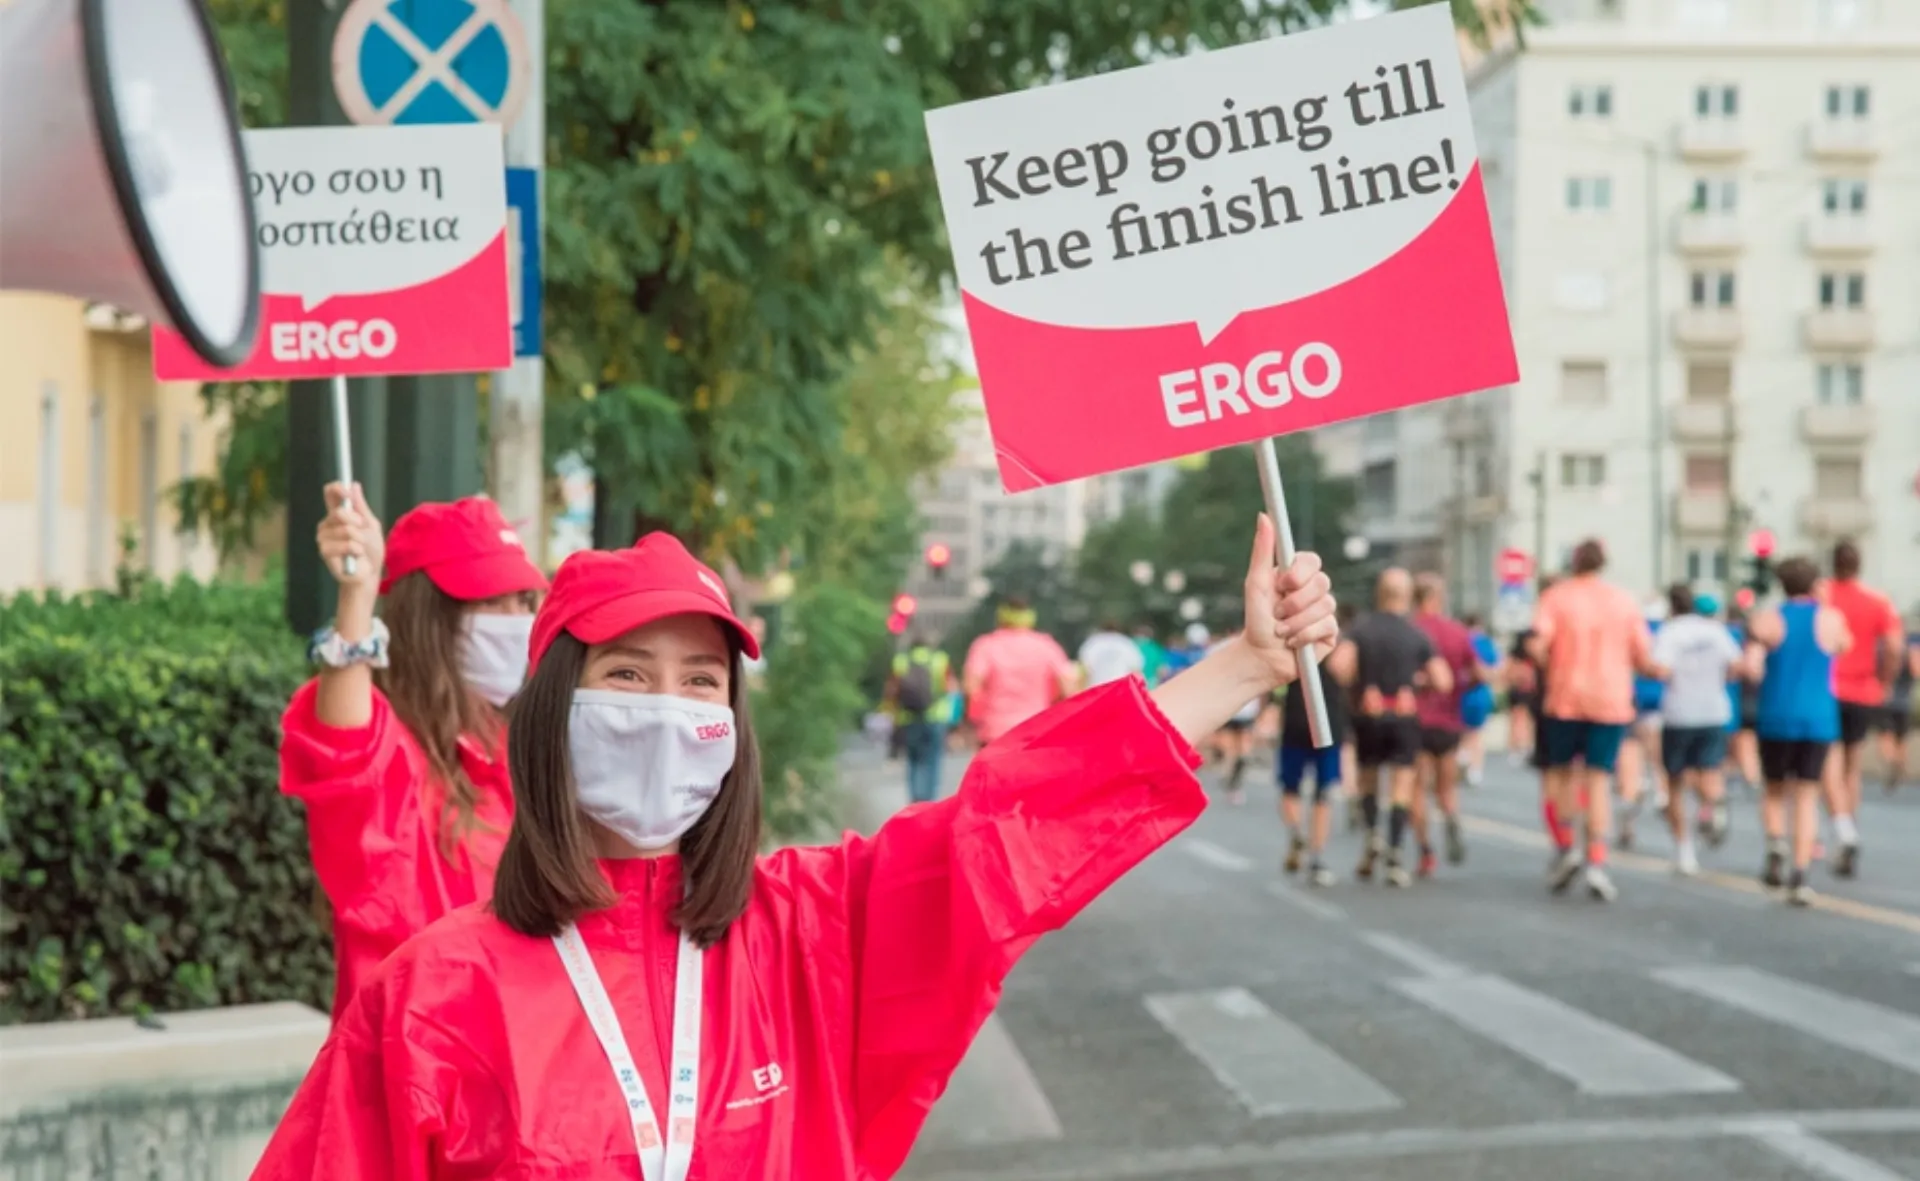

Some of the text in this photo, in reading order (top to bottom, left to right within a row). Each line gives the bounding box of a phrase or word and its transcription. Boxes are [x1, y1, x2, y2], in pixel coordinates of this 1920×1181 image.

[964, 58, 1445, 208] Keep going till
[328, 168, 406, 194] σου
[419, 166, 443, 200] η
[258, 208, 459, 248] οσπάθεια
[979, 138, 1460, 286] the finish line!
[271, 318, 397, 361] ERGO
[1159, 341, 1342, 428] ERGO
[695, 721, 730, 741] ERGO
